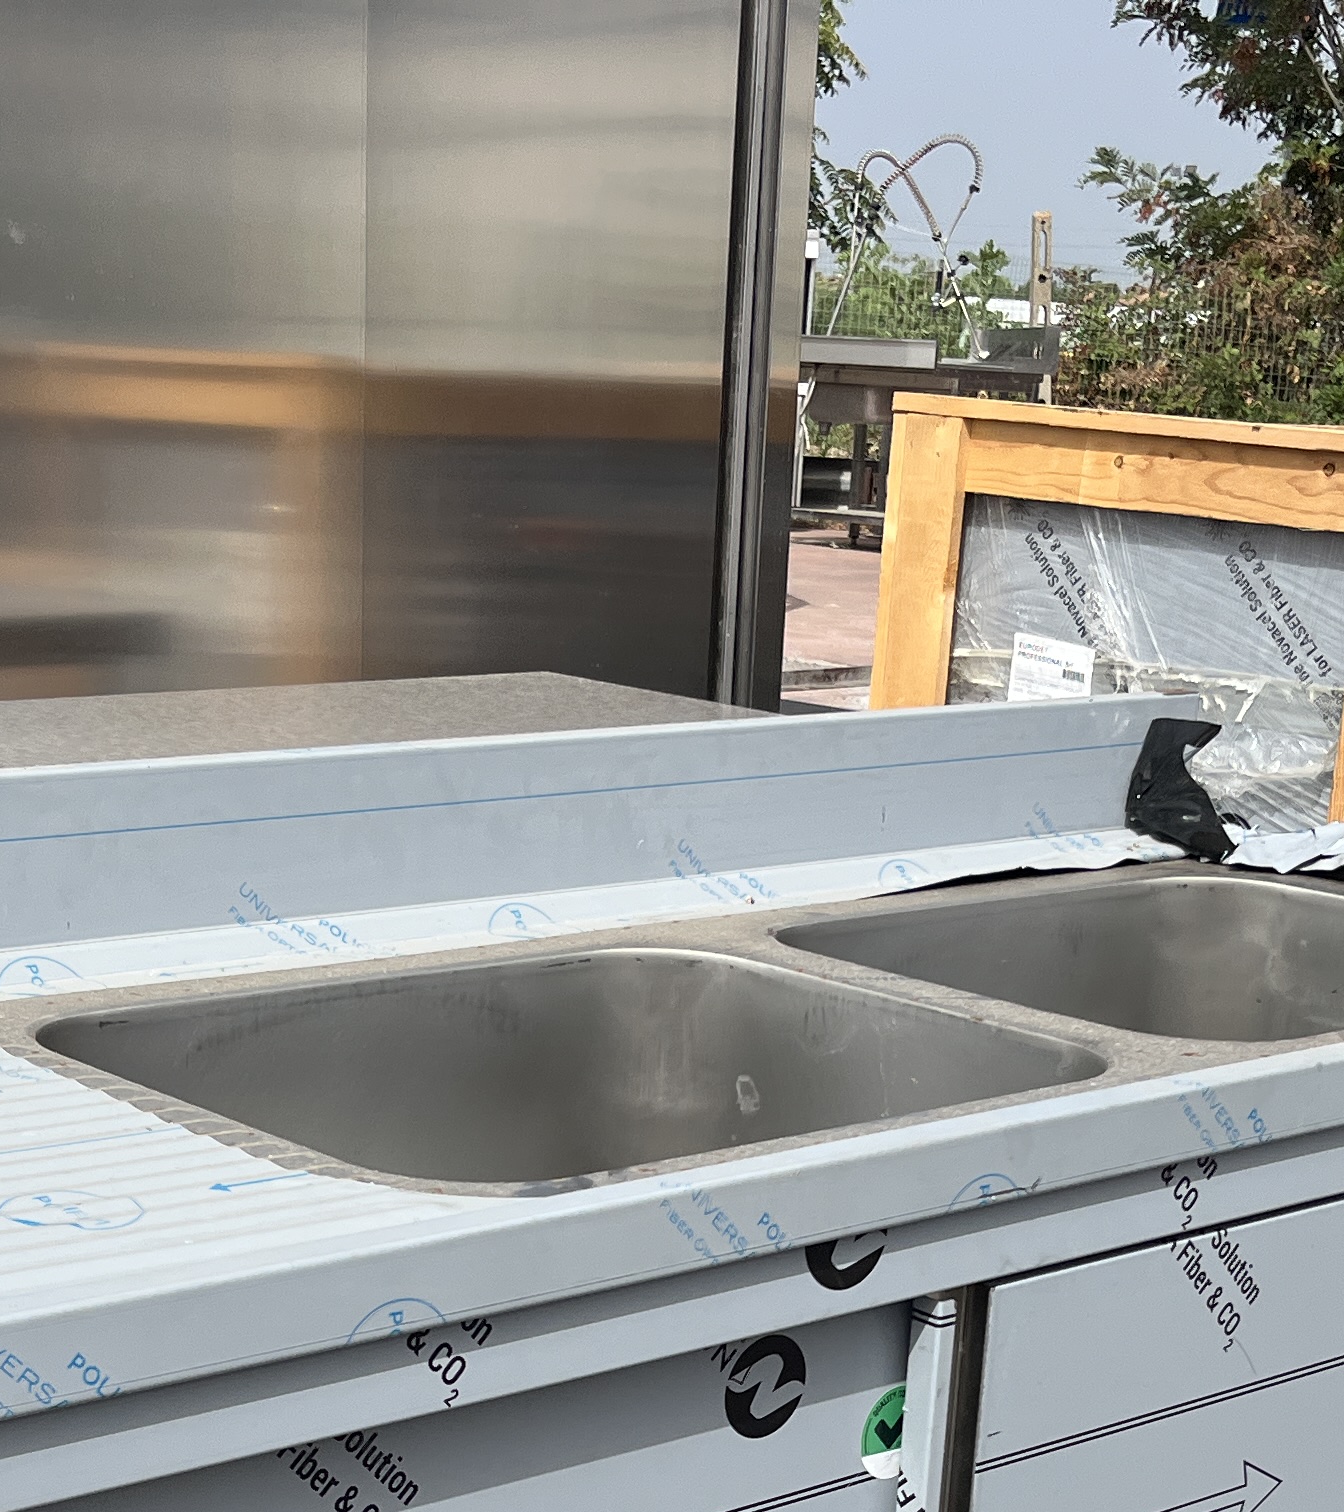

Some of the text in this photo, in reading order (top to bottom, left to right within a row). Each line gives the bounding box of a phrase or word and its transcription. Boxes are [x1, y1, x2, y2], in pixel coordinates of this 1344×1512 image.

[1025, 532, 1059, 591] Solution
[1057, 550, 1080, 587] Fiber
[1224, 554, 1262, 613] Solution
[1261, 573, 1289, 612] Fiber
[1255, 610, 1298, 666] Novacel
[1283, 607, 1318, 658] LASER
[1315, 653, 1332, 679] for
[1175, 1239, 1212, 1293] Fiber
[1205, 1286, 1225, 1312] &
[1210, 1227, 1261, 1306] Solution
